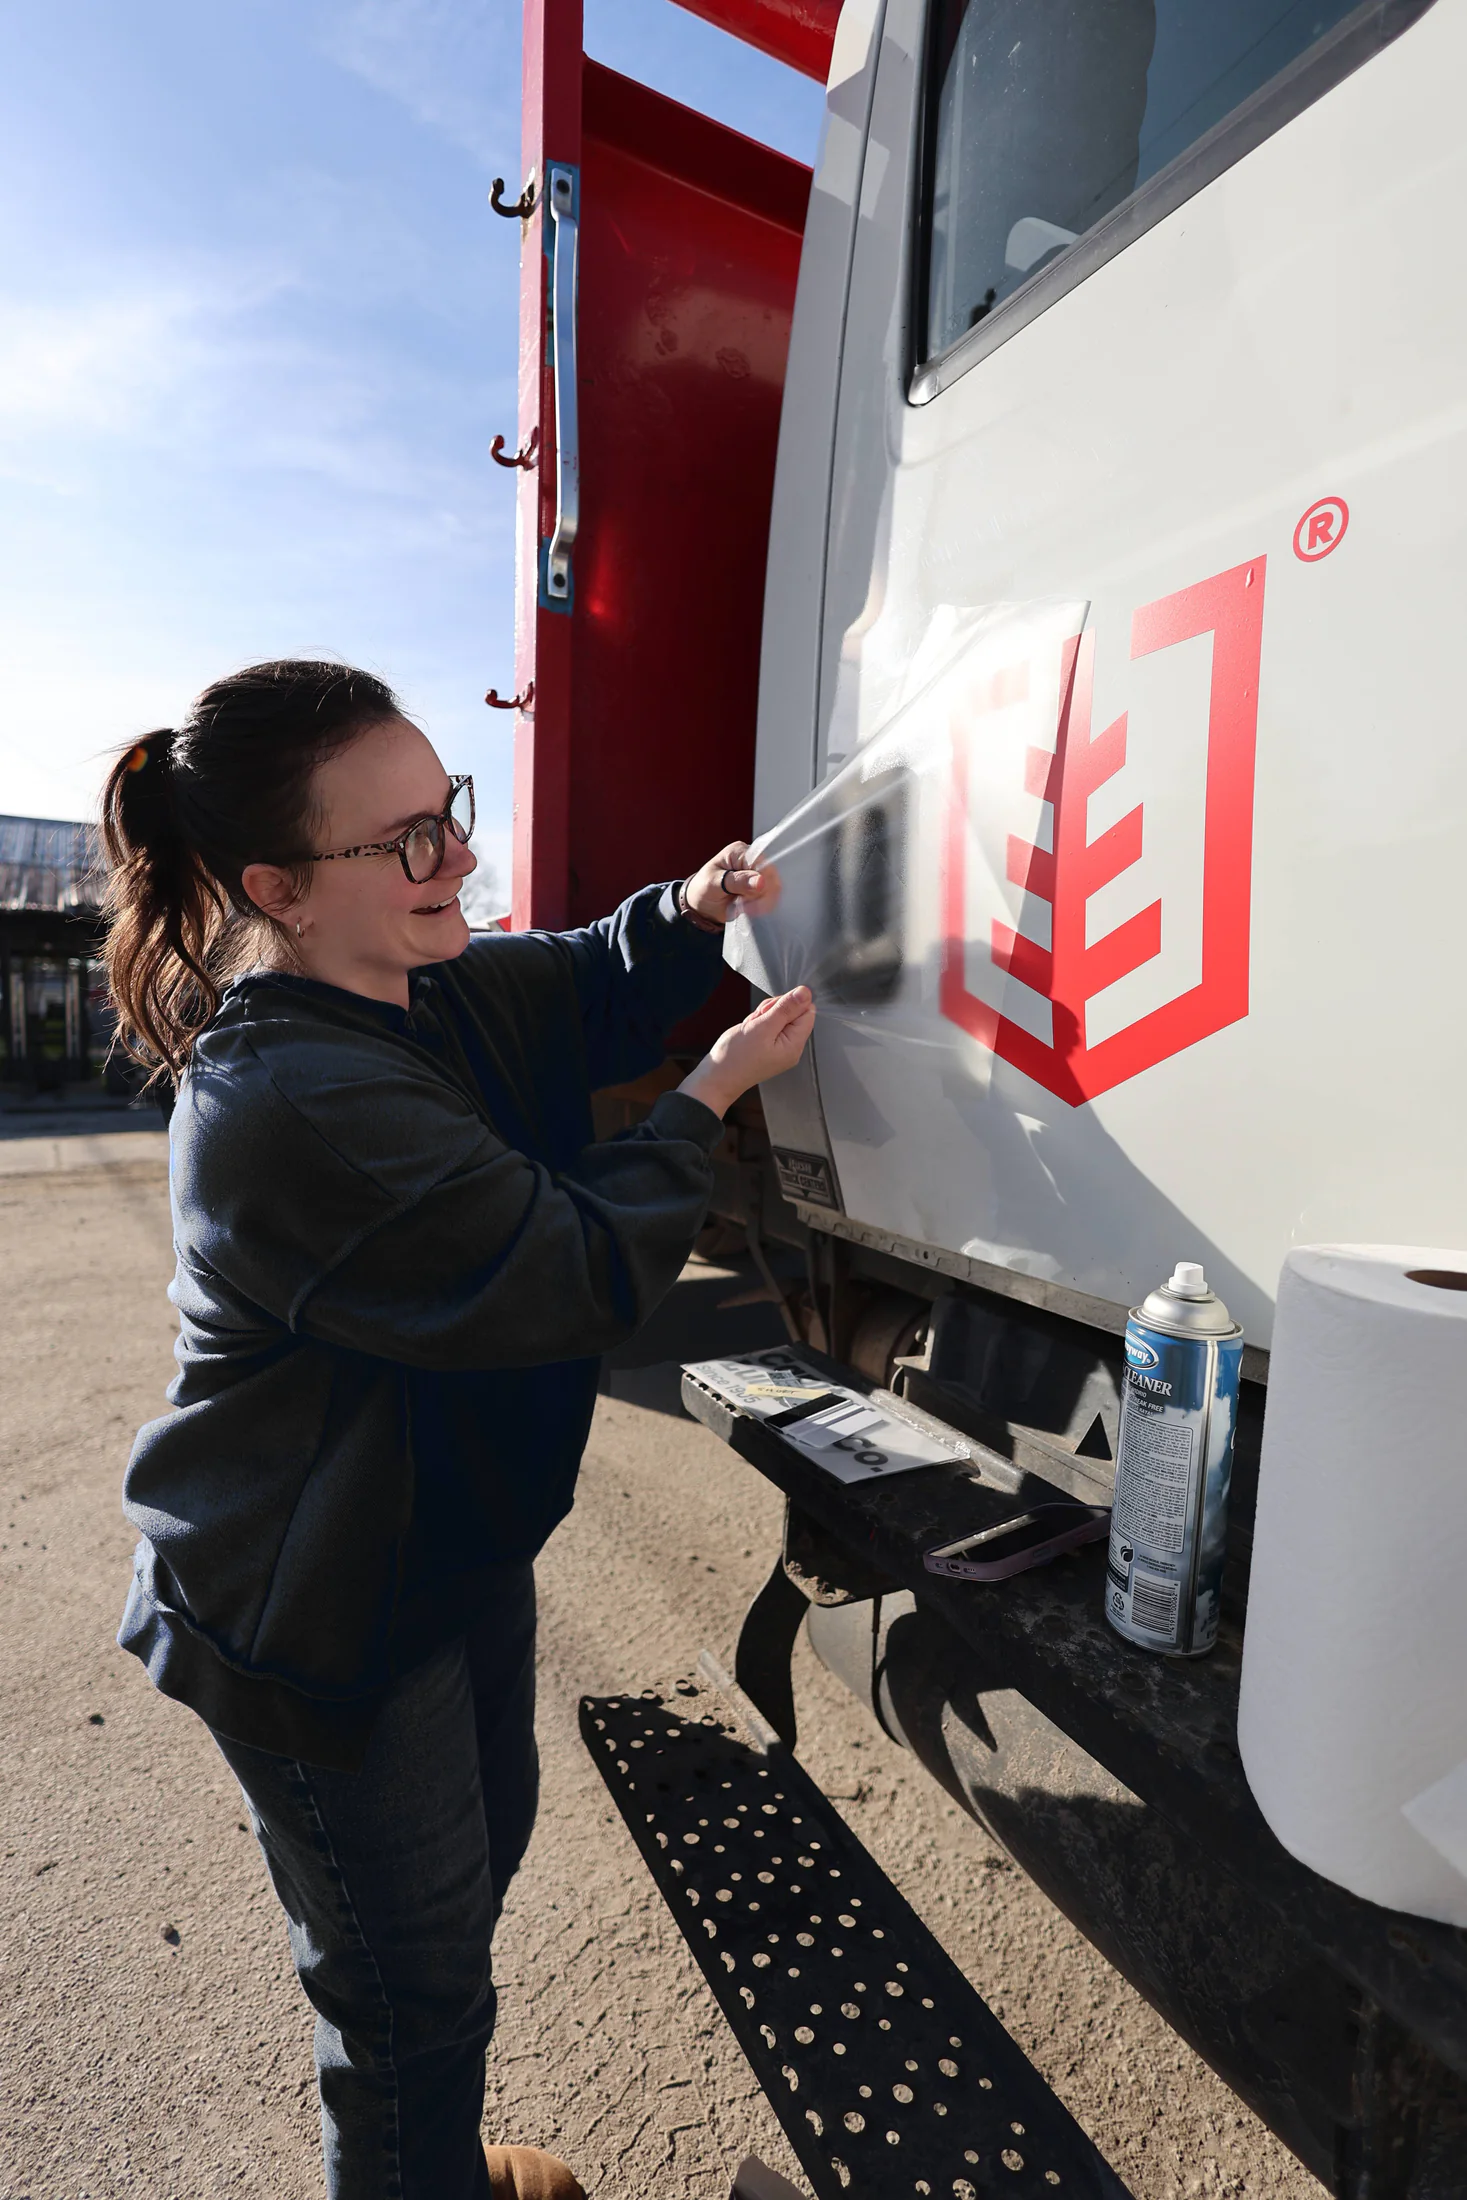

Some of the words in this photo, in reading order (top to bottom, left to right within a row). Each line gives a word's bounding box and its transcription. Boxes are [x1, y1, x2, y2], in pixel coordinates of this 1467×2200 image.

[696, 1364, 730, 1385] since
[1124, 1367, 1173, 1397] CLEANER
[1148, 1402, 1164, 1413] FREE
